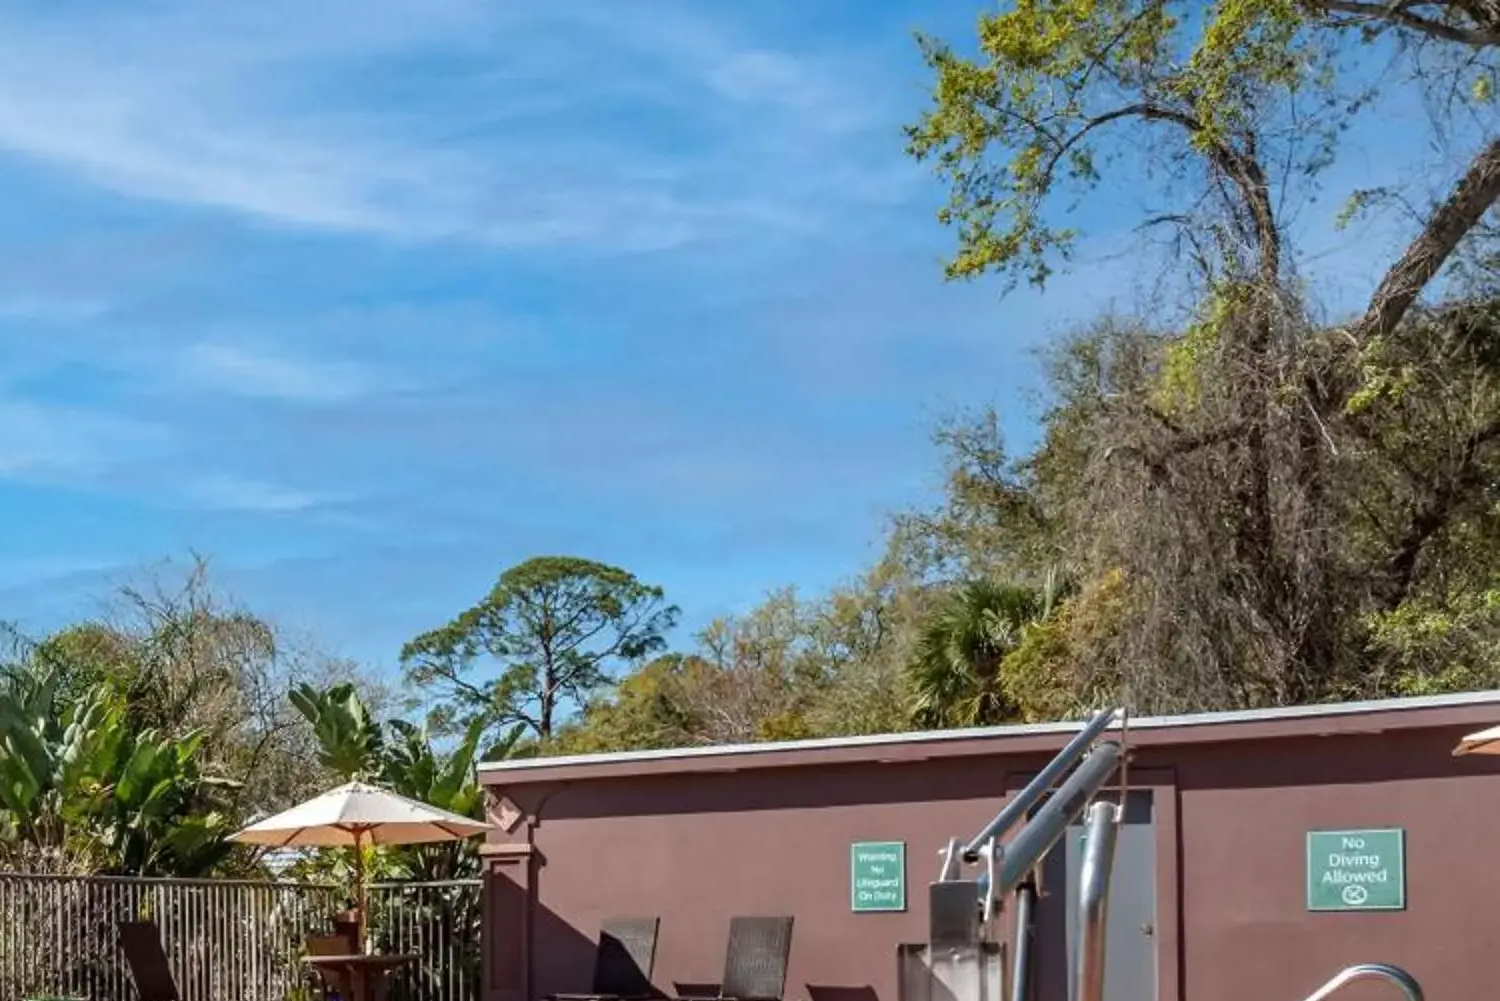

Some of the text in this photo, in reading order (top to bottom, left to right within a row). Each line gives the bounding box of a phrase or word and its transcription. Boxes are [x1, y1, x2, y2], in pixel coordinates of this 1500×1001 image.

[1341, 836, 1365, 849] No
[1329, 853, 1380, 868] Diving
[870, 865, 884, 875] No
[1322, 868, 1388, 884] Allowed
[858, 891, 873, 901] On
